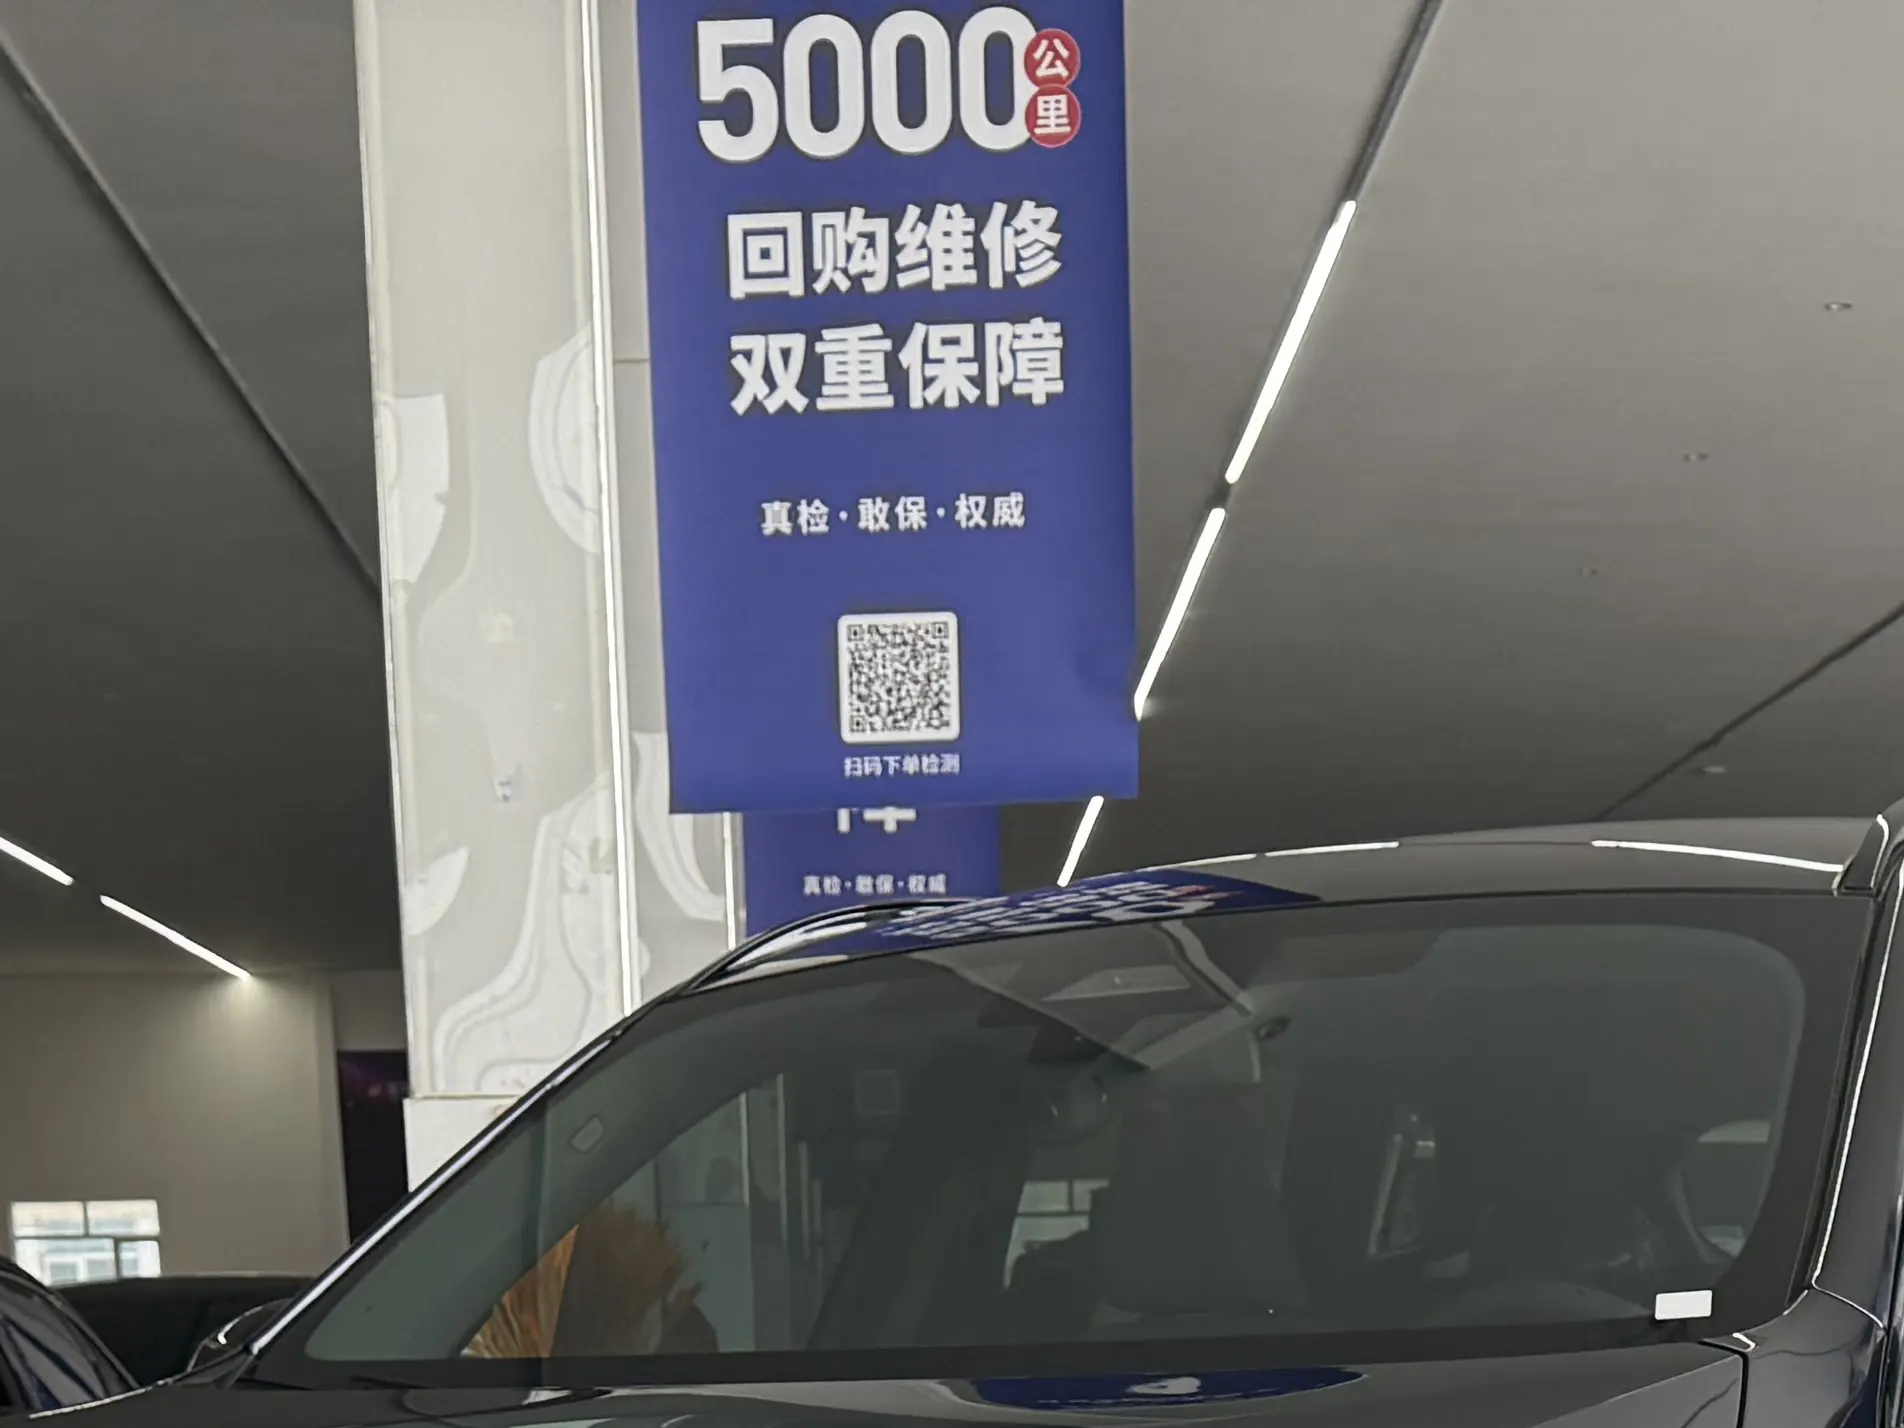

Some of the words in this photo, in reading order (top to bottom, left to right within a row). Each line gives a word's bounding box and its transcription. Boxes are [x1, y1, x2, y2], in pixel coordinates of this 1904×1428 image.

[696, 6, 1044, 162] 5000
[1032, 38, 1072, 136] 公里
[727, 200, 1063, 300] 回购维修
[730, 317, 1066, 416] 双重保障
